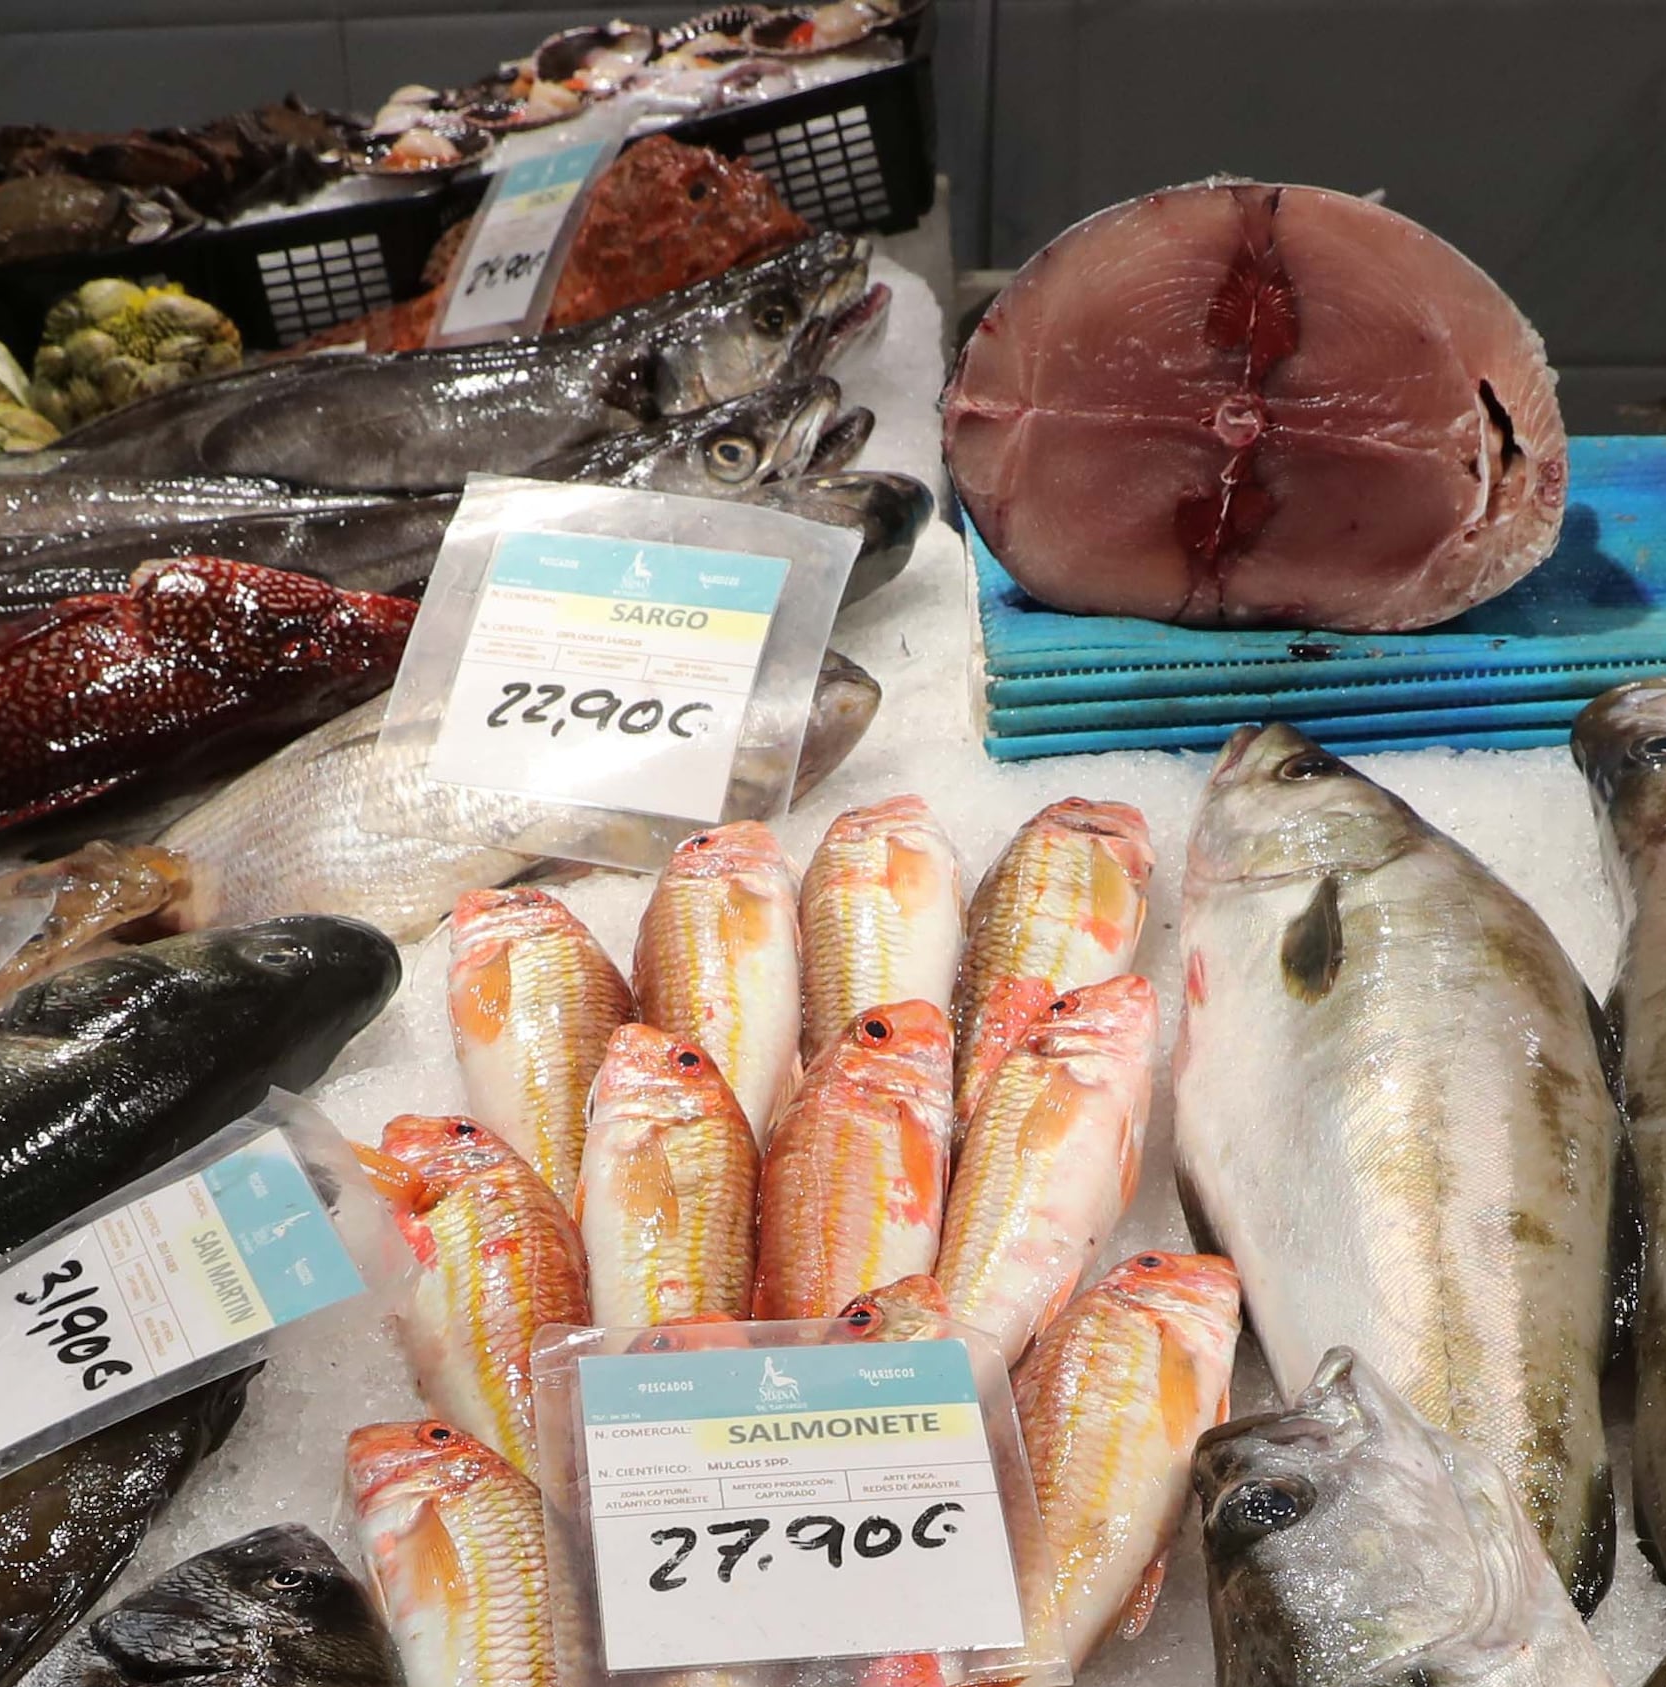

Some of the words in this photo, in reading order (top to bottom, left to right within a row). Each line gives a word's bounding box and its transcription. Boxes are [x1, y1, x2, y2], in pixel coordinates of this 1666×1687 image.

[608, 600, 711, 632] SARGO
[191, 1230, 227, 1265] SAN
[206, 1261, 257, 1325] MARTIN
[637, 1380, 694, 1393] PESCADOS
[858, 1366, 916, 1386] MARISCOS
[594, 1430, 607, 1439] N.
[609, 1425, 692, 1439] COMERCIAL:
[726, 1411, 941, 1445] SALMONETE
[597, 1468, 611, 1478] N.
[615, 1462, 692, 1478] CIENTÍFICO:
[706, 1458, 763, 1471] MULCUS
[754, 1487, 817, 1500] CAPTURADO
[890, 1482, 905, 1491] DE
[604, 1498, 661, 1510] ATLANTICO
